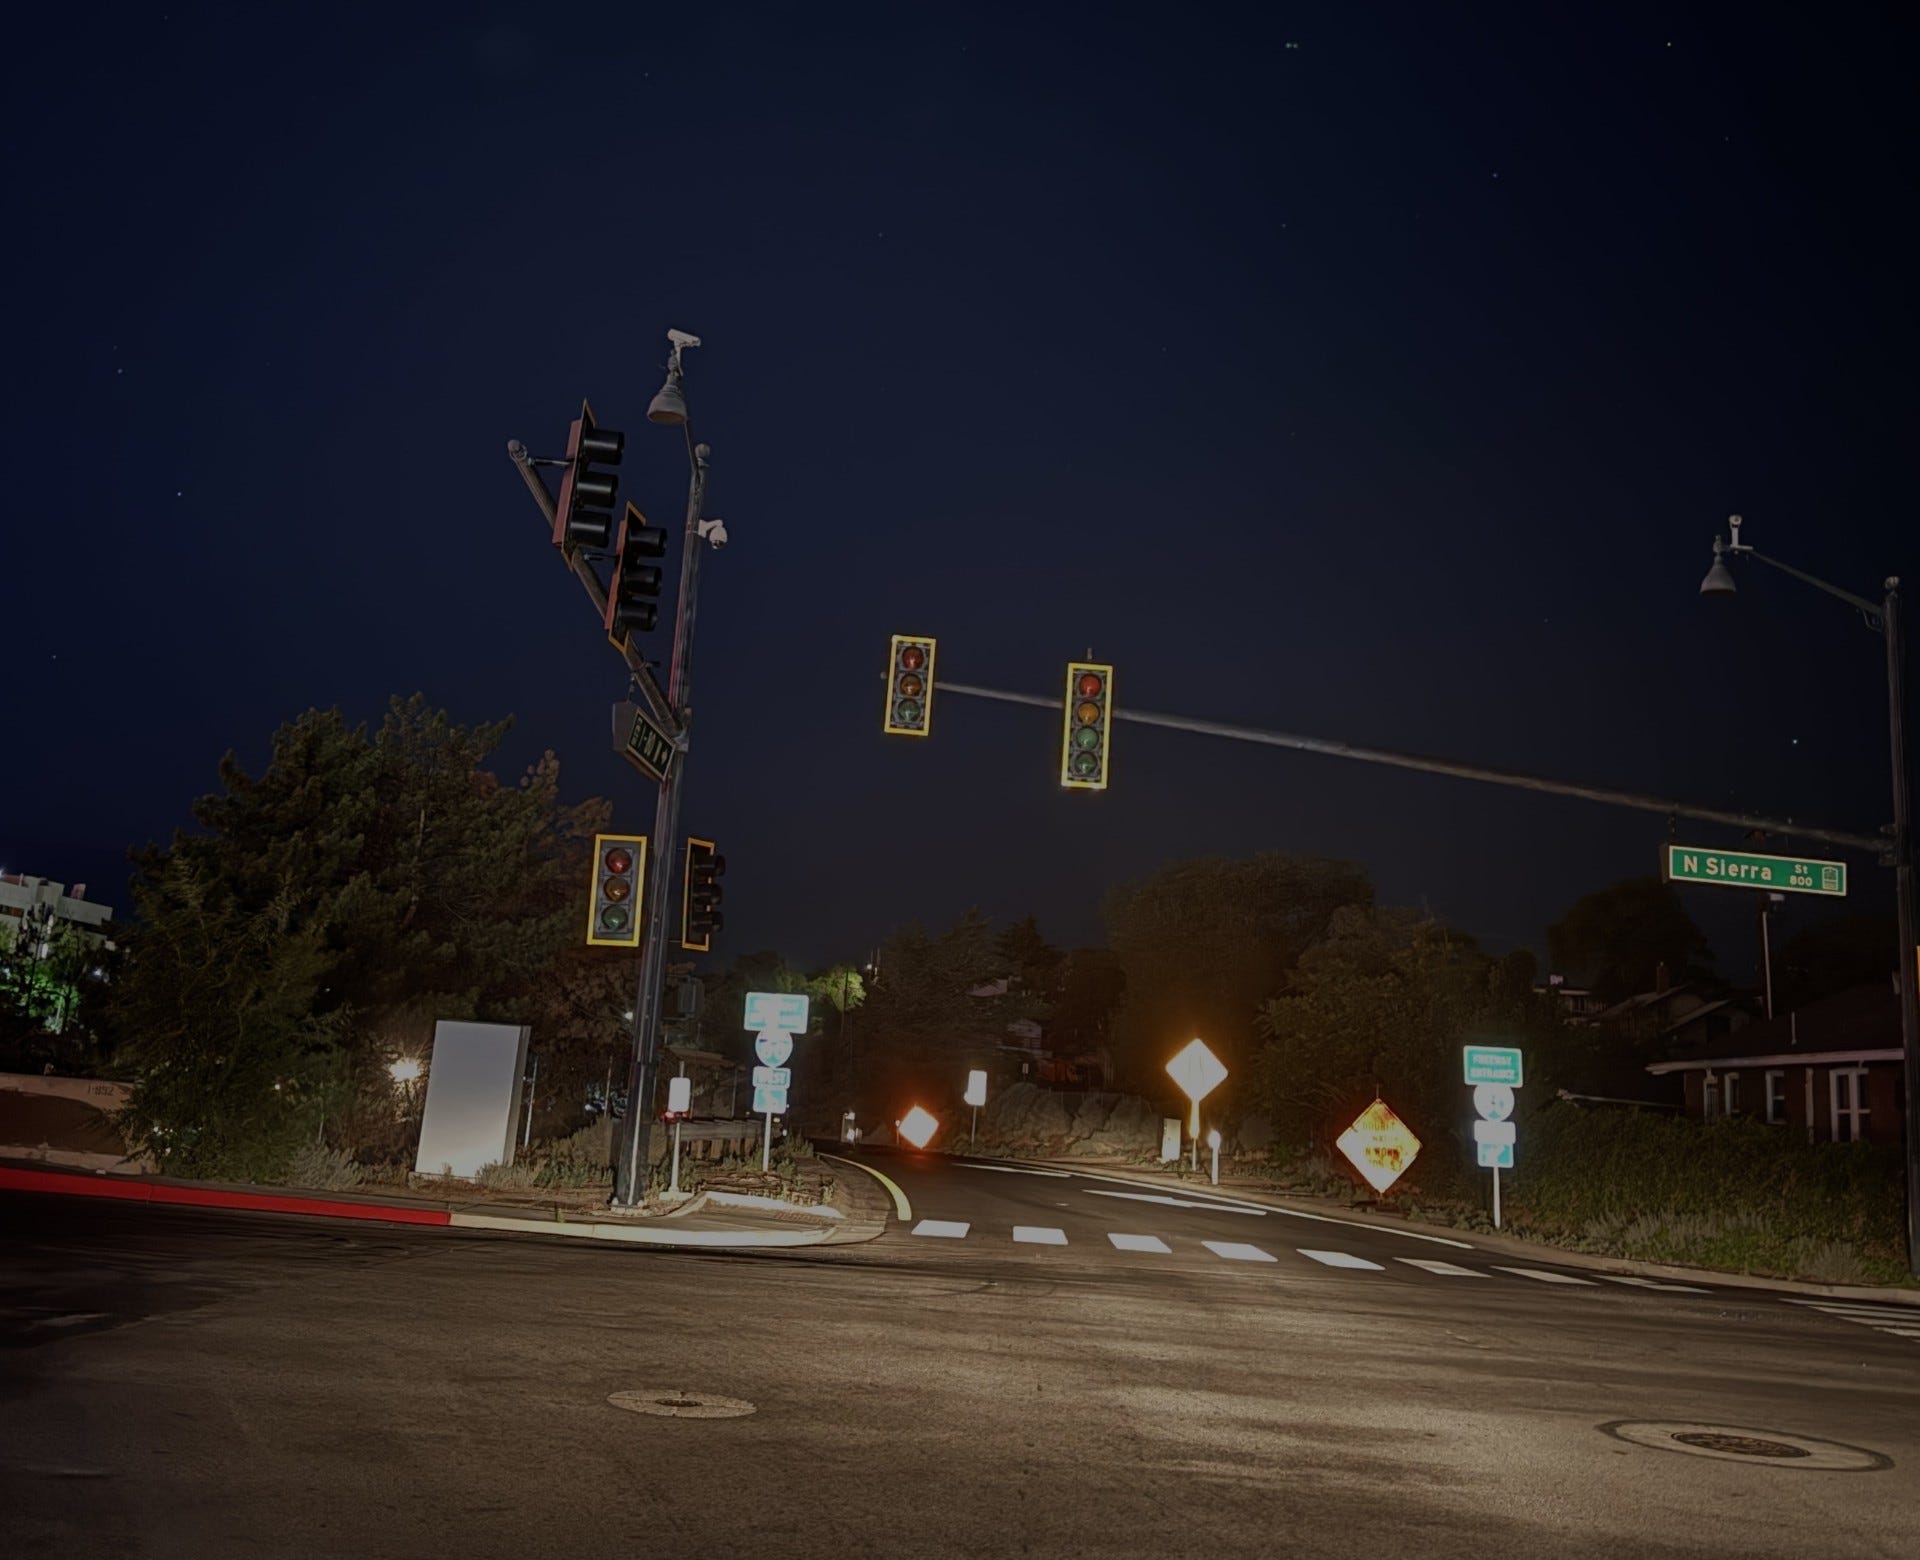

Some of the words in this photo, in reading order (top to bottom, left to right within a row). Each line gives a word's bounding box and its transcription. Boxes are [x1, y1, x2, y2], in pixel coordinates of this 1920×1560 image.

[1683, 855, 1698, 874] N
[1706, 858, 1772, 880] Sierra
[1794, 864, 1809, 874] St
[1789, 875, 1813, 887] 800
